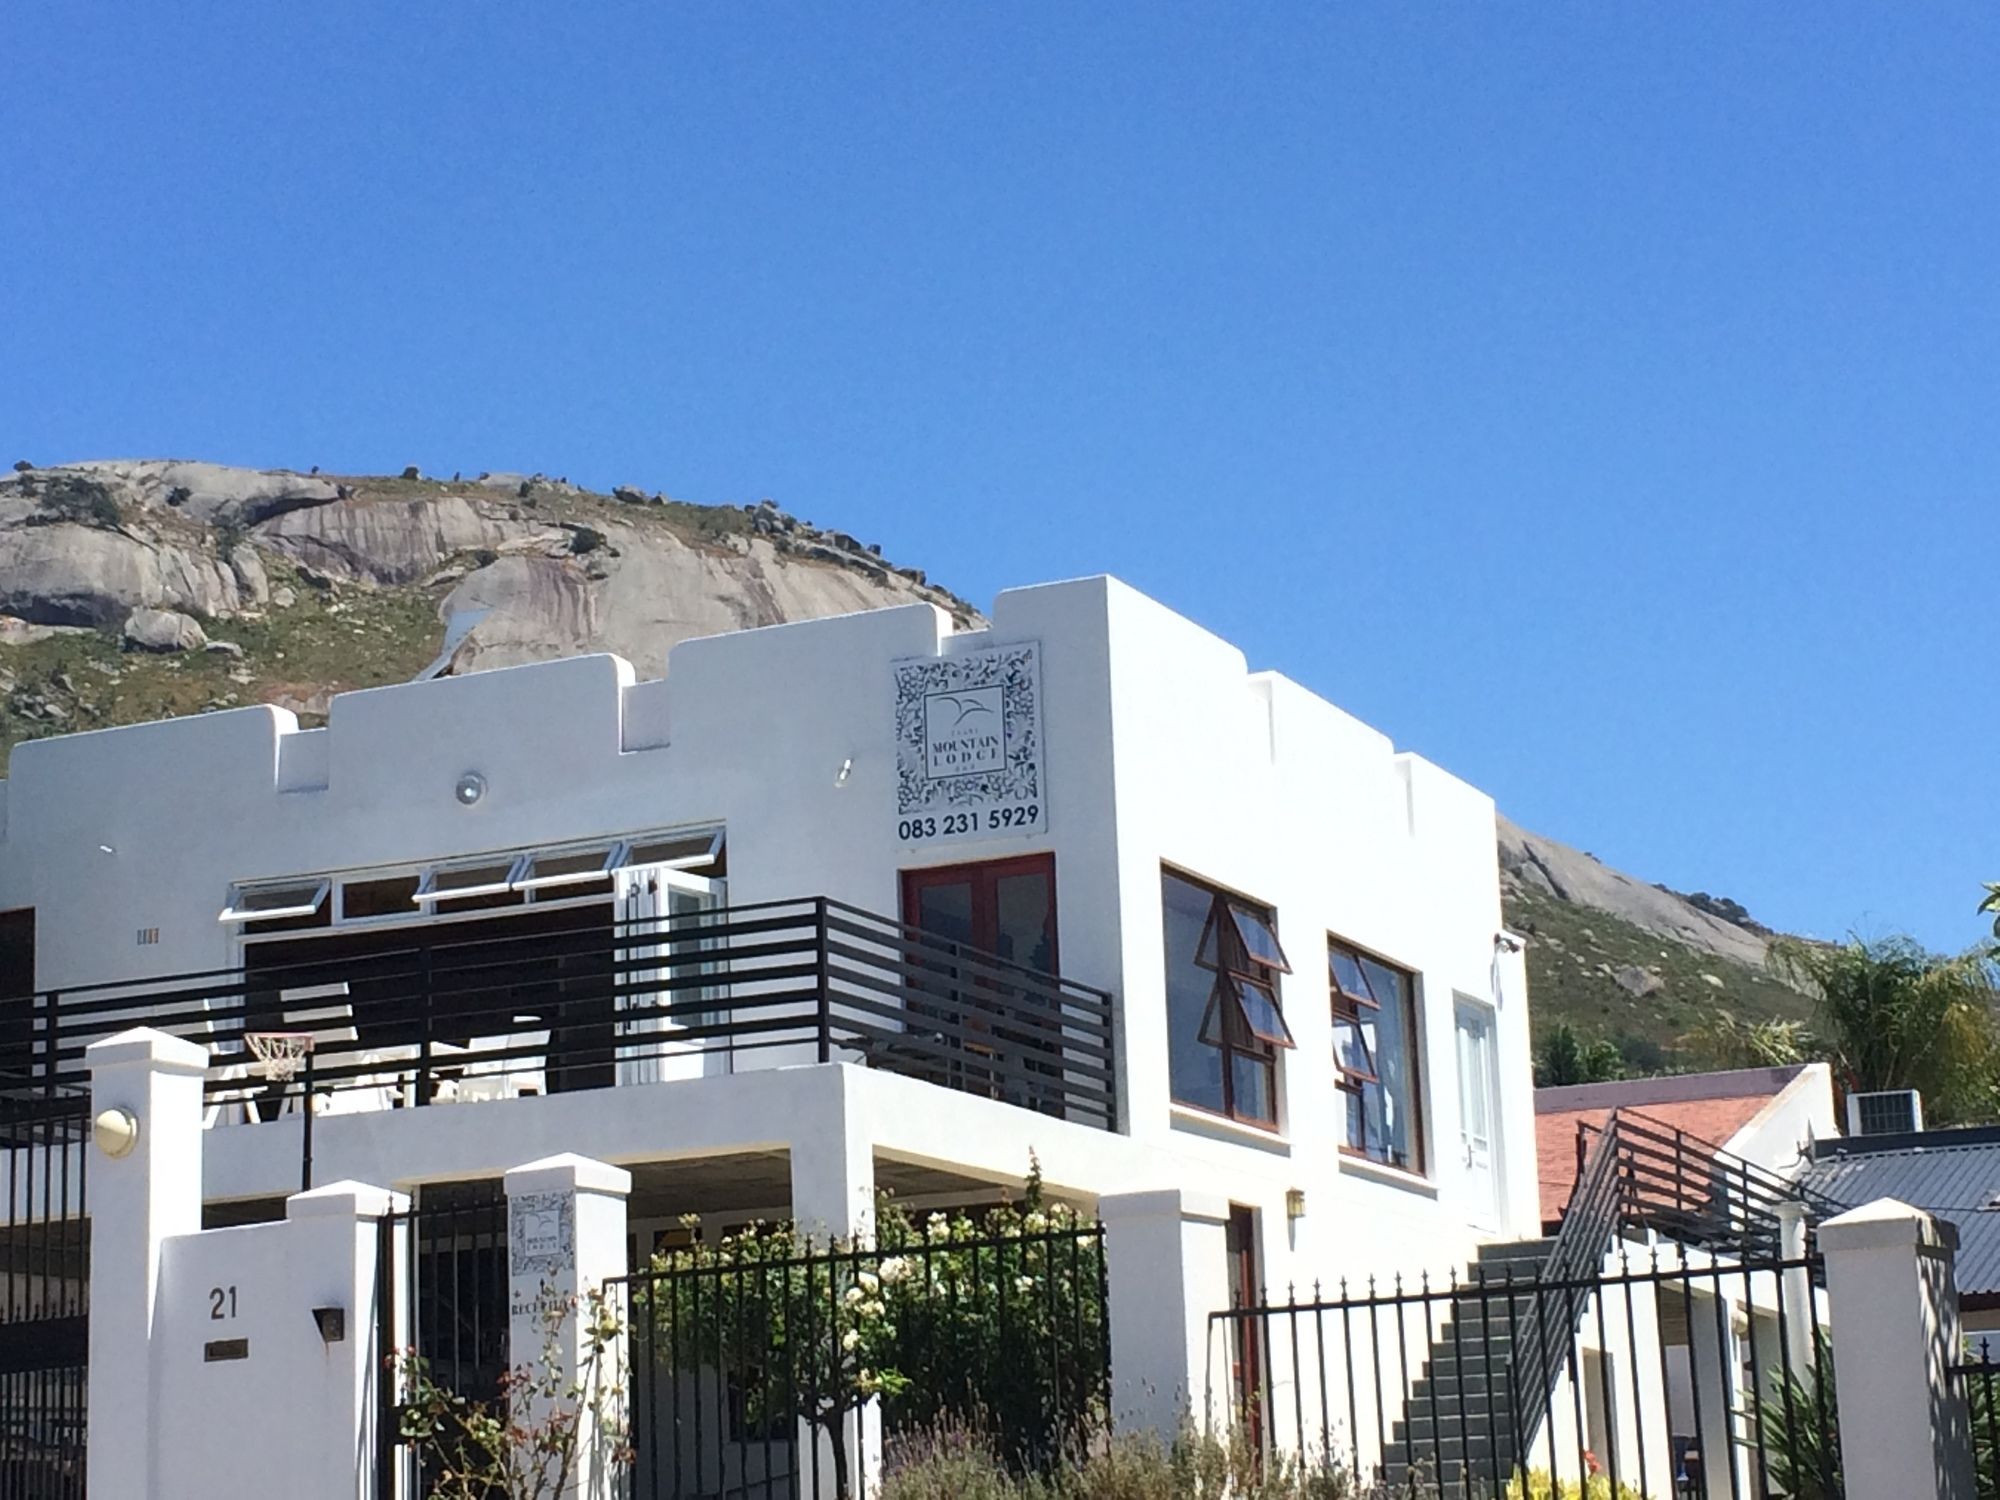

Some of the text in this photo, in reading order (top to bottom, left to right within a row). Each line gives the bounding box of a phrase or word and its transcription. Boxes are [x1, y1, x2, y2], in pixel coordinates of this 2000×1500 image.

[933, 735, 999, 753] MOUNTAIN
[934, 748, 996, 767] LODGE
[899, 804, 1039, 840] 083 231 5929
[209, 1285, 236, 1320] 21
